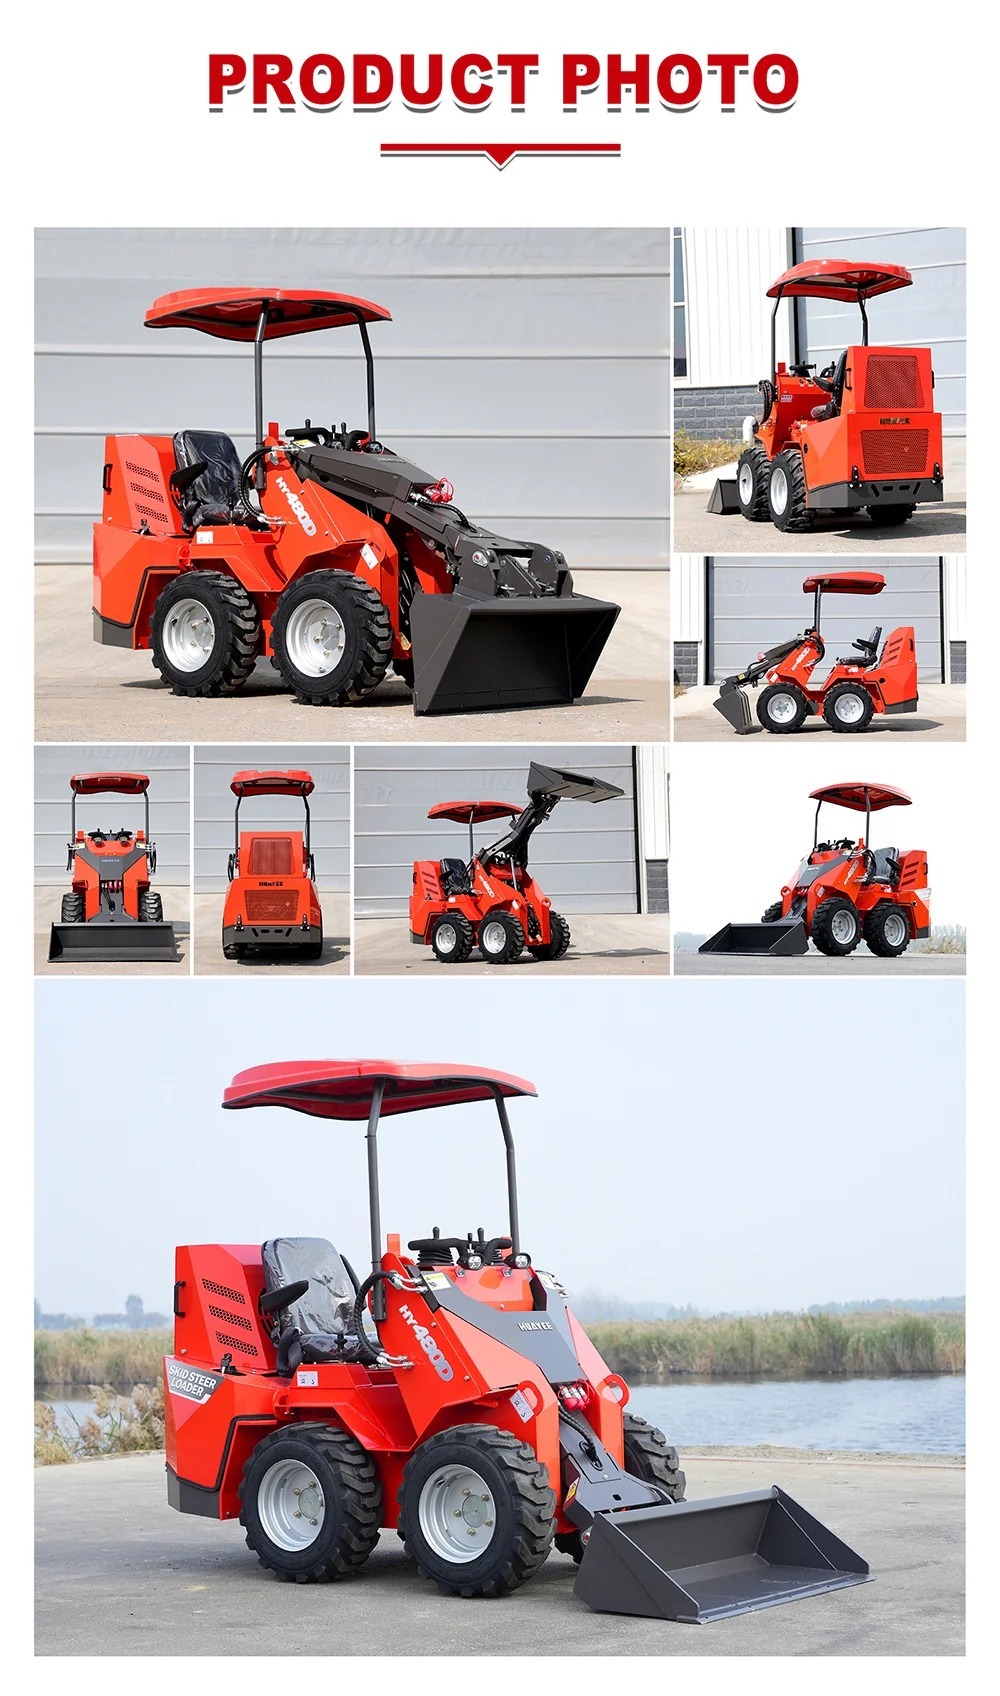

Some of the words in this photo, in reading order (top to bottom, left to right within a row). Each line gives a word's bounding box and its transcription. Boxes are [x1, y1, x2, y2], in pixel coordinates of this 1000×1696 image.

[517, 1321, 554, 1332] HUAYEE
[398, 1304, 454, 1382] HY480D
[169, 1365, 189, 1379] SKID
[188, 1371, 217, 1390] STEER
[170, 1376, 205, 1397] LOADER
